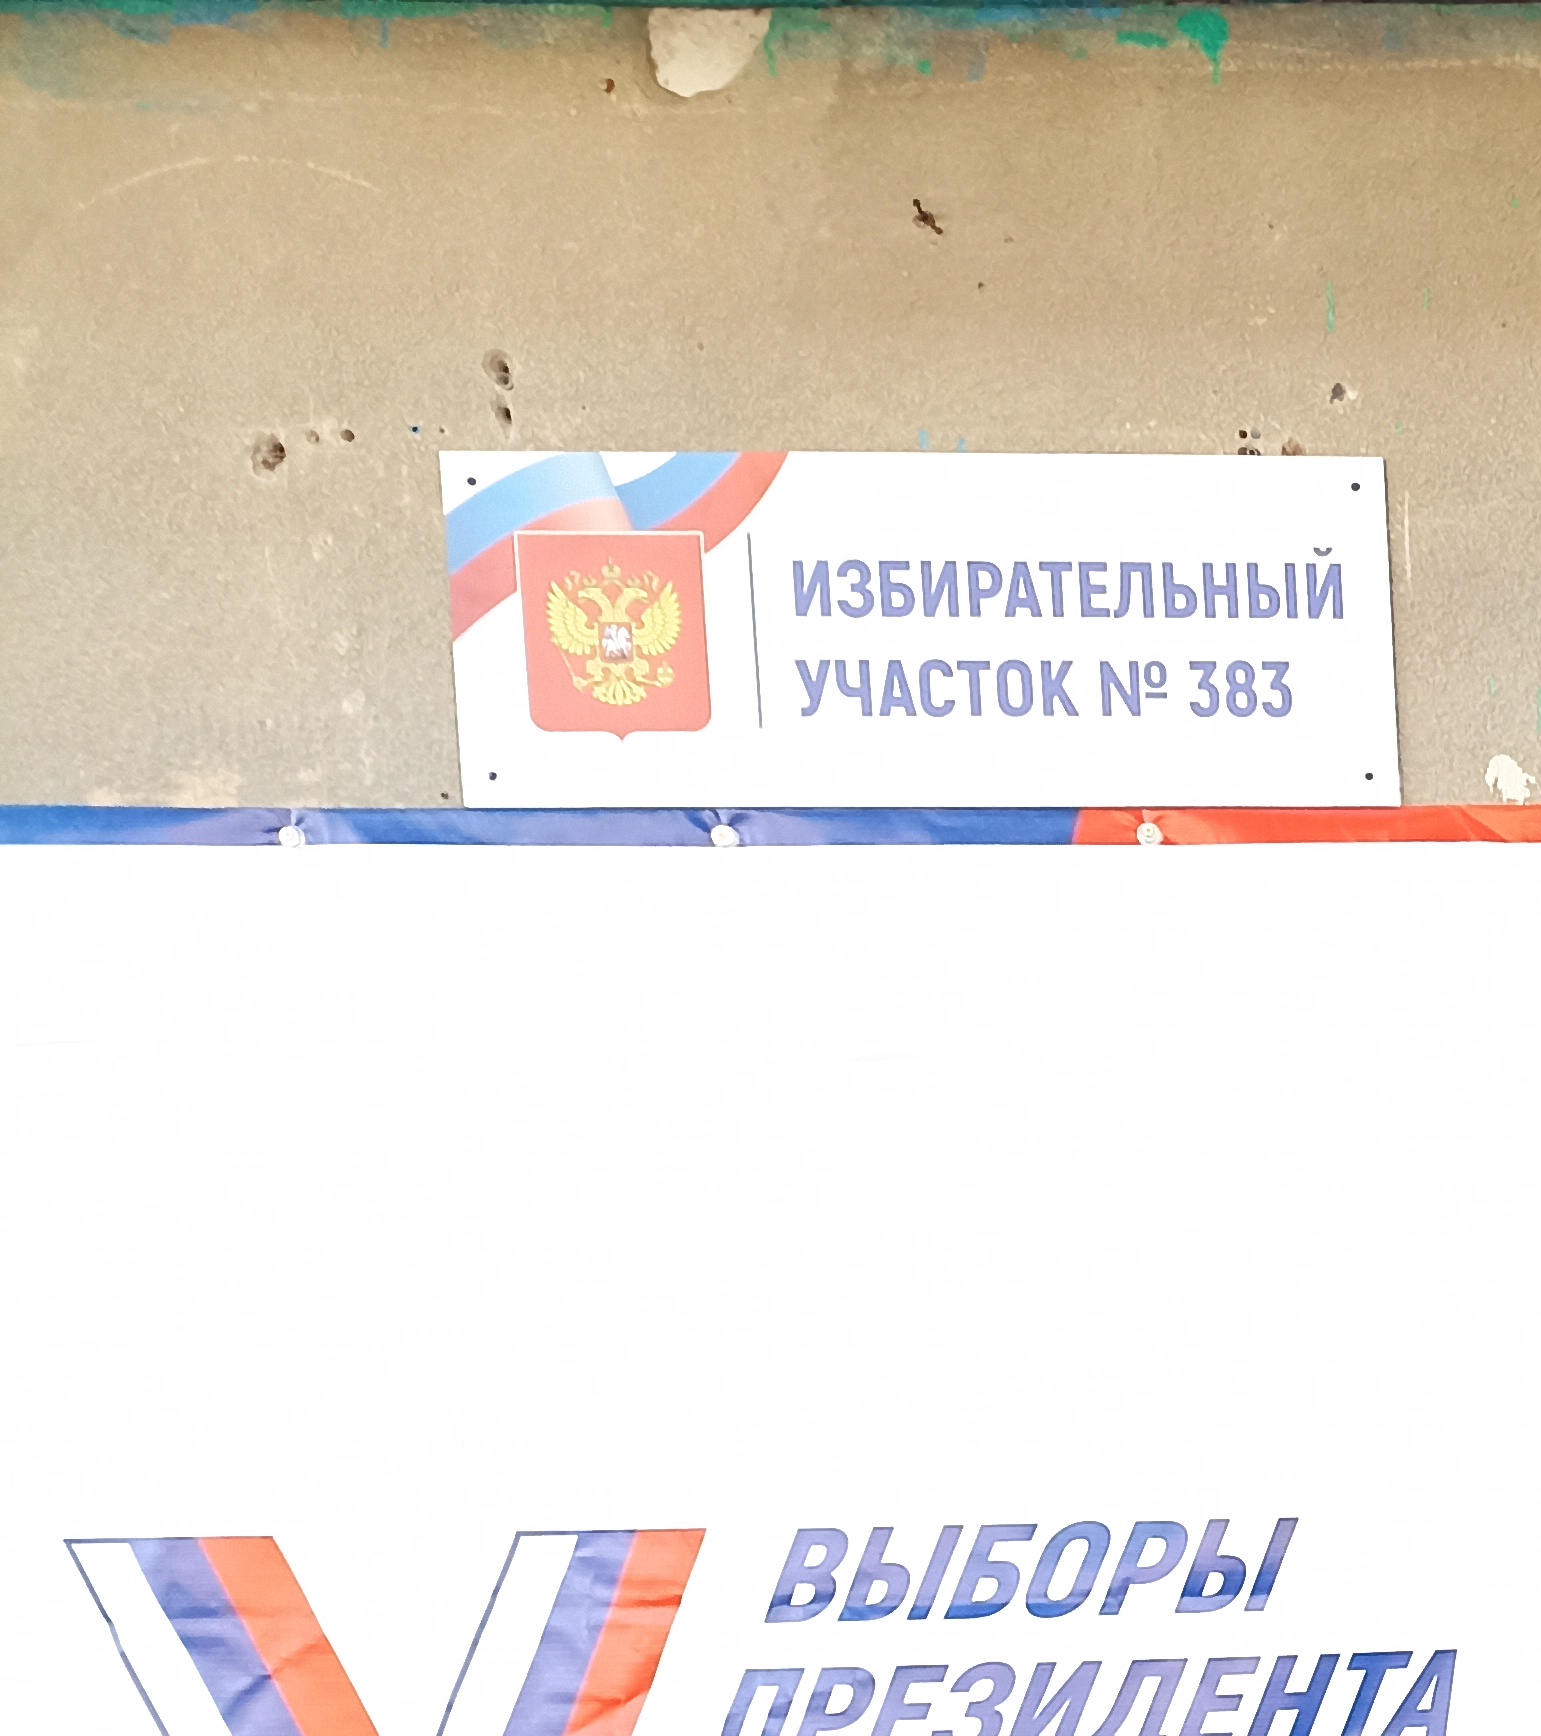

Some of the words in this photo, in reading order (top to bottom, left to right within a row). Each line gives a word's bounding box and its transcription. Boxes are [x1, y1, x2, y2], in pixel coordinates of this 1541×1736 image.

[792, 546, 1345, 620] ИЗБИРАТЕЛЬНЫЙ
[795, 659, 1079, 719] УЧАСТОК
[1100, 660, 1168, 718] №
[1189, 660, 1293, 719] 383
[765, 1516, 1299, 1624] ВЫБОРЫ
